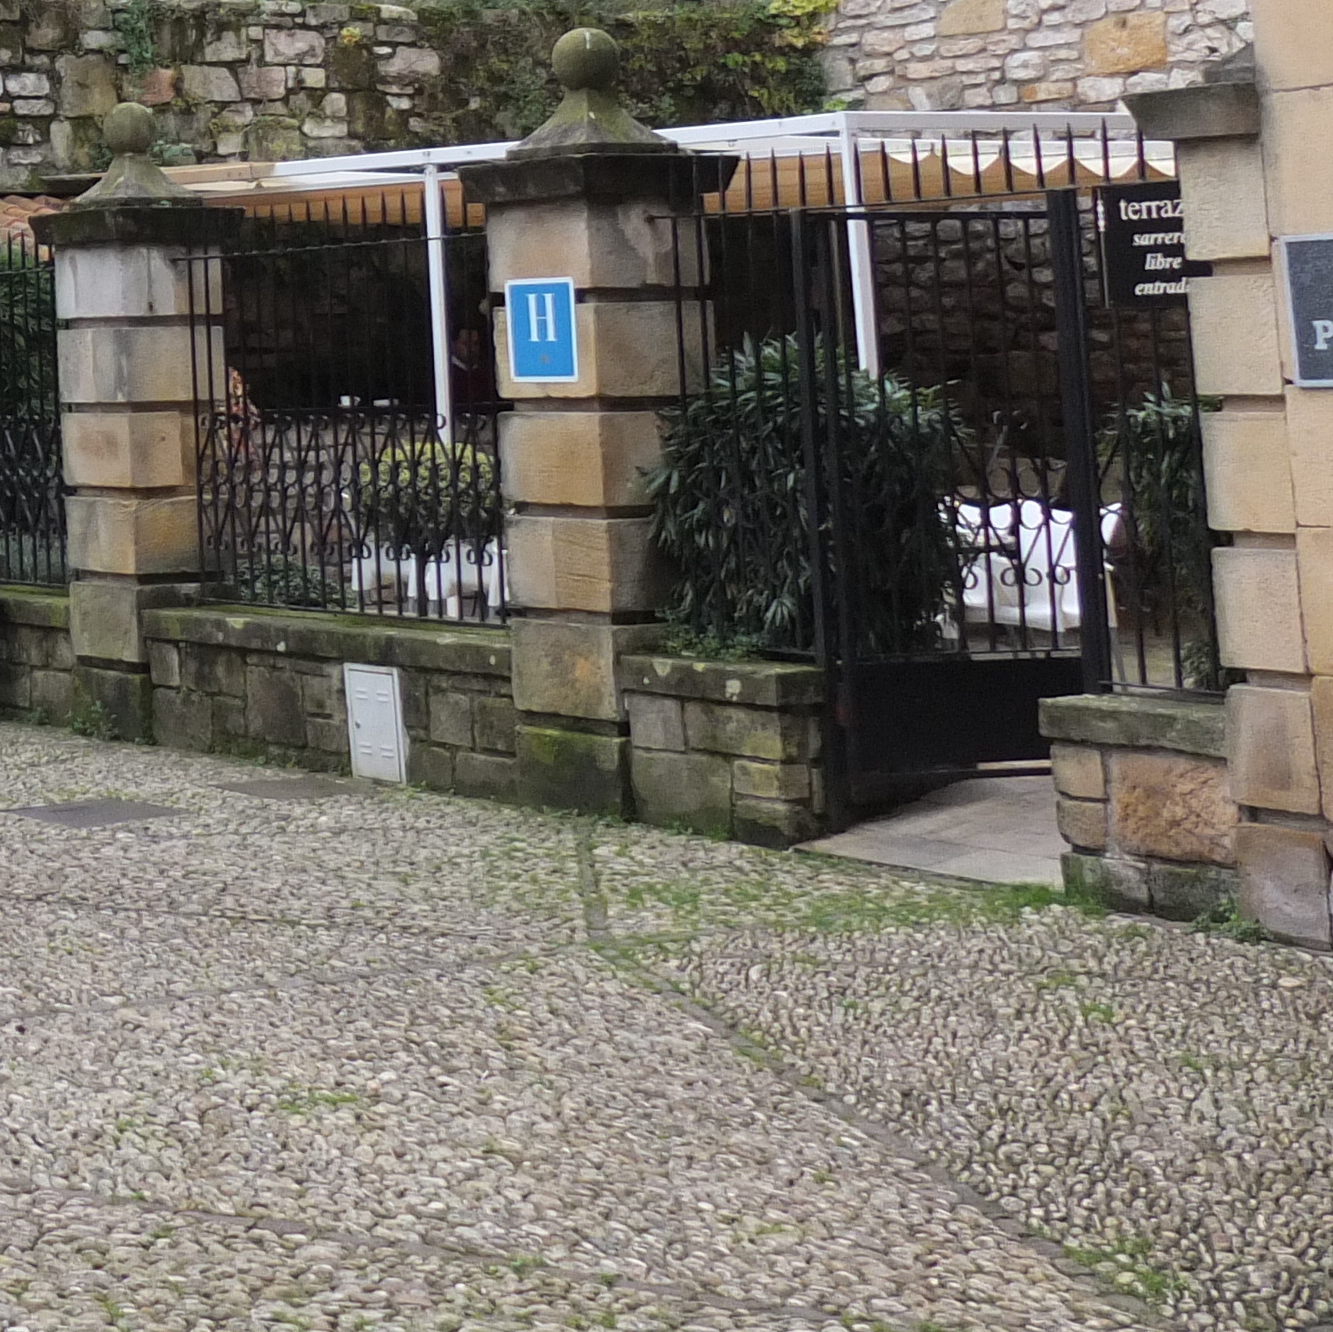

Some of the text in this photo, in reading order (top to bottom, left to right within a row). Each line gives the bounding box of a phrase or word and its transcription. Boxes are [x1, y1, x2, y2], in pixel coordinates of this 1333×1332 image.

[1119, 198, 1184, 220] terraz
[1145, 253, 1182, 270] libre
[525, 293, 558, 342] H
